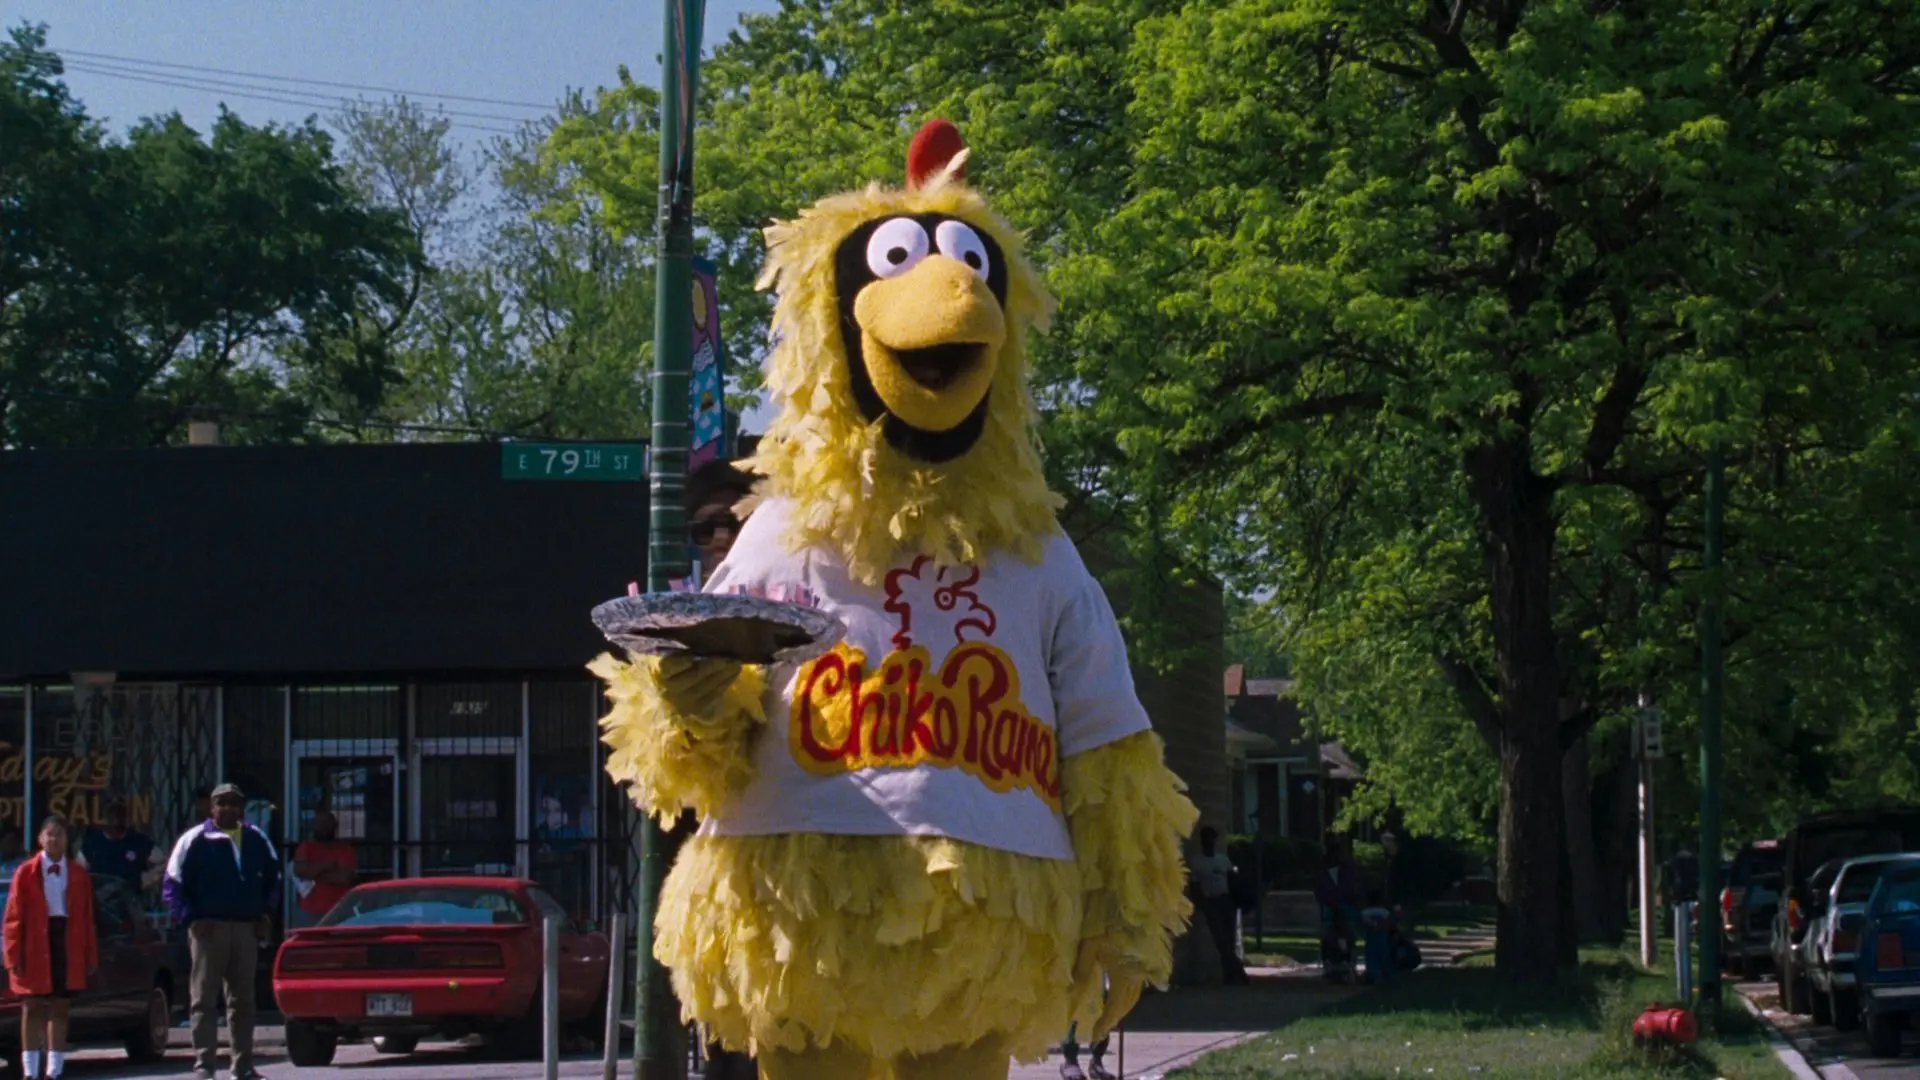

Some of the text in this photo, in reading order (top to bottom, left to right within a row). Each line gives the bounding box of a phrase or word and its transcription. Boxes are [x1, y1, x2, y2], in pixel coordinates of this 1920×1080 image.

[519, 454, 529, 469] E
[614, 455, 630, 470] ST
[50, 795, 149, 826] SALN
